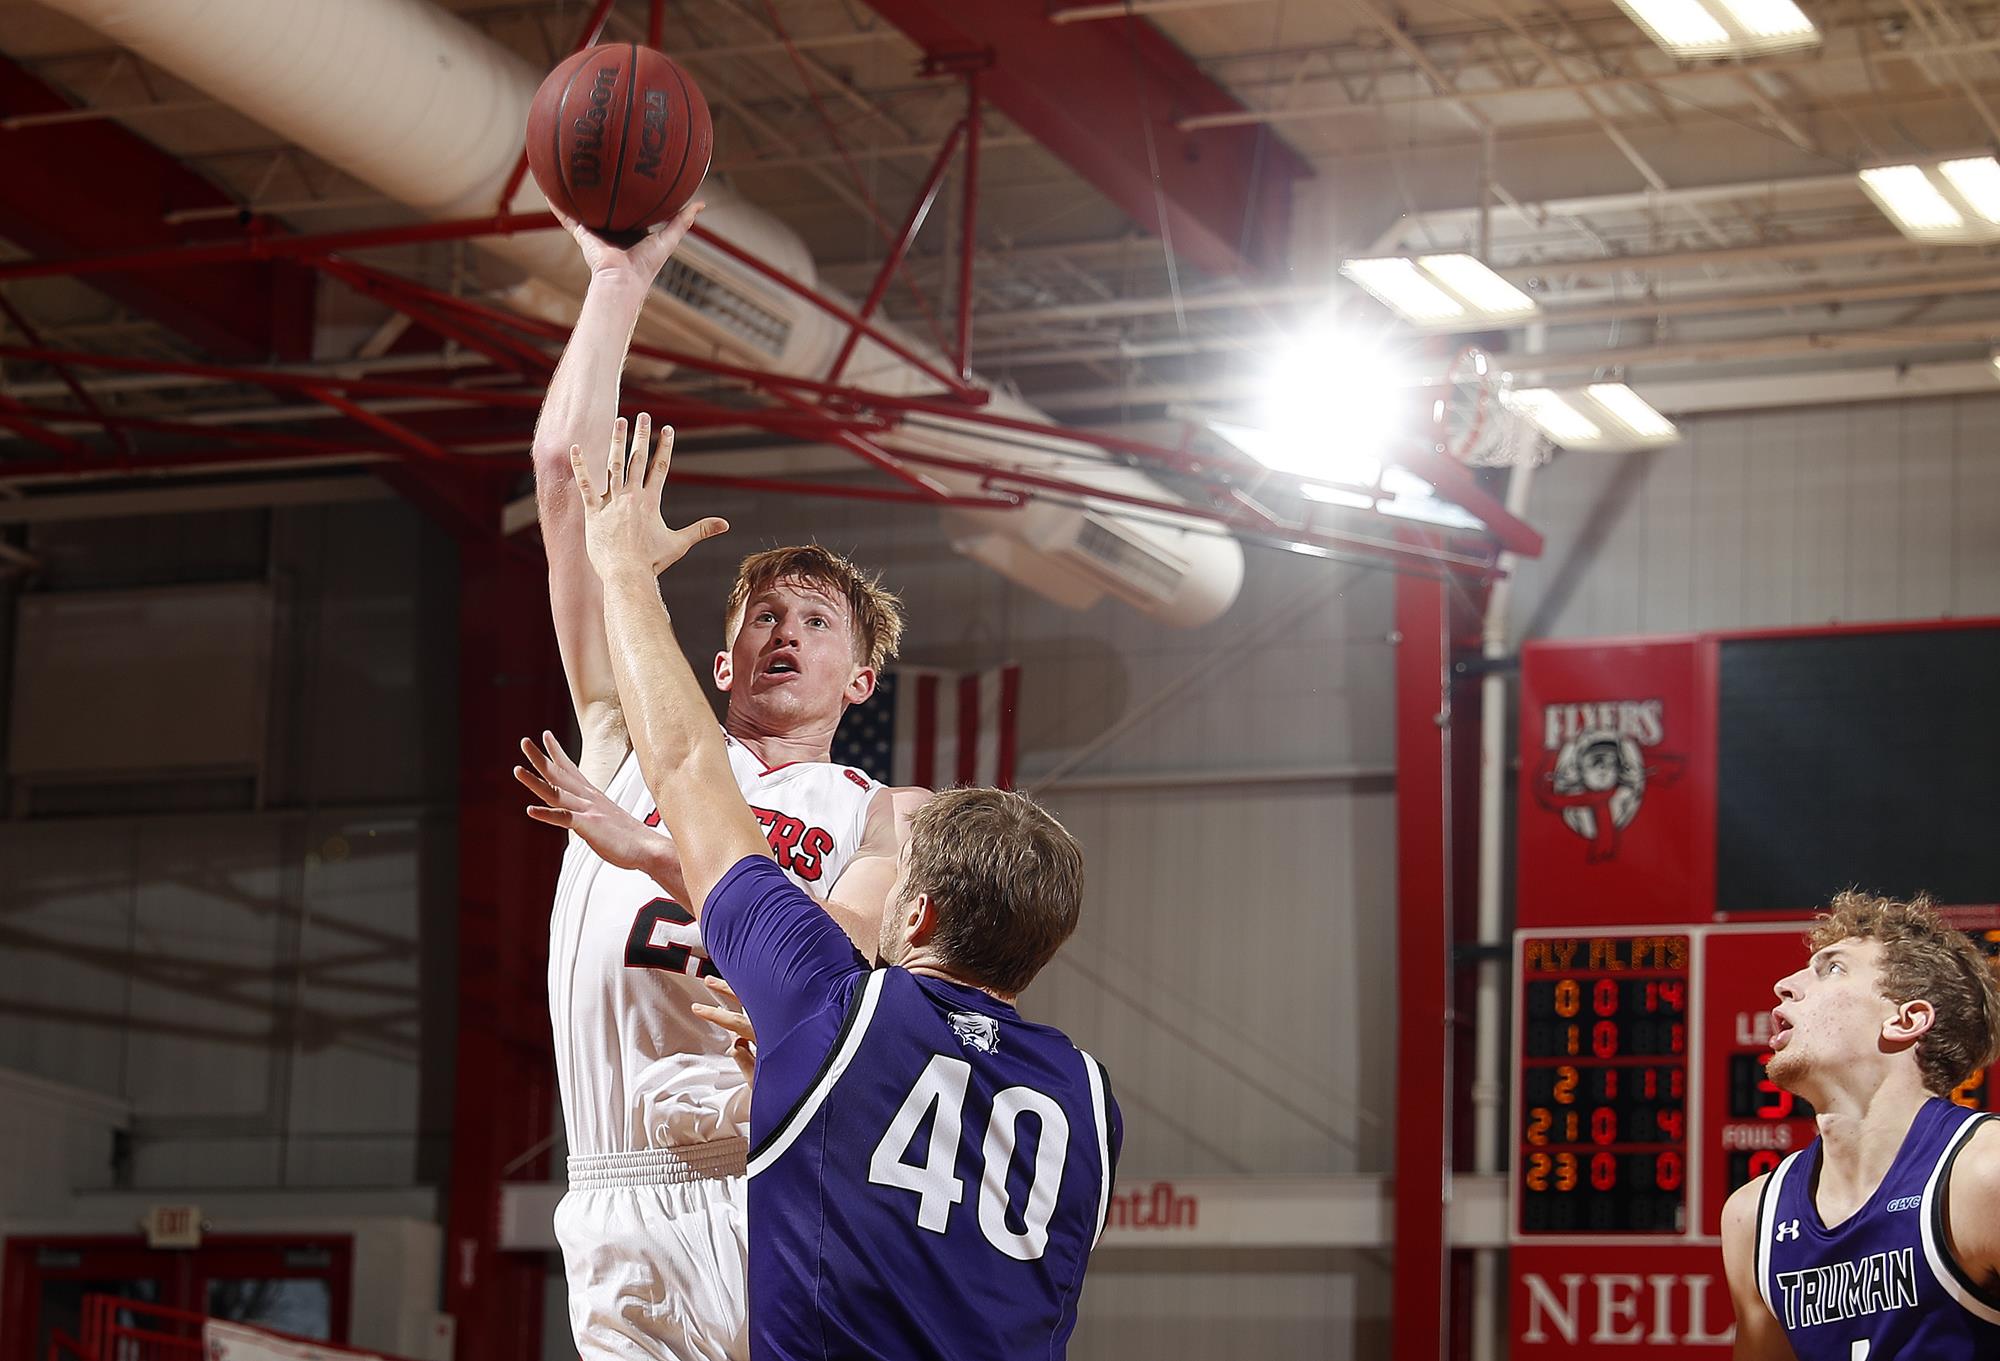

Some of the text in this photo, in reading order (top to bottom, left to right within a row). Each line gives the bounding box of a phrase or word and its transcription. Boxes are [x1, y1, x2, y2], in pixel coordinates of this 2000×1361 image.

[571, 65, 622, 187] Wilson
[634, 88, 668, 179] NCAA
[1545, 700, 1664, 750] FLYERS
[624, 897, 721, 979] 2
[1631, 936, 1686, 969] PTS
[1555, 979, 1683, 1018] 0 0 14
[1567, 1020, 1683, 1059] 1 0 1
[1554, 1065, 1683, 1104] 2 1 11
[1527, 1107, 1682, 1146] 21 0 4
[1722, 1124, 1793, 1150] FOULS
[868, 1054, 1069, 1261] 40
[1526, 1152, 1682, 1191] 23 0 0
[158, 1207, 192, 1235] EXIT
[1887, 1195, 1921, 1212] GLVC
[1776, 1247, 1918, 1330] TRUMAN
[1521, 1273, 1737, 1345] NEIL
